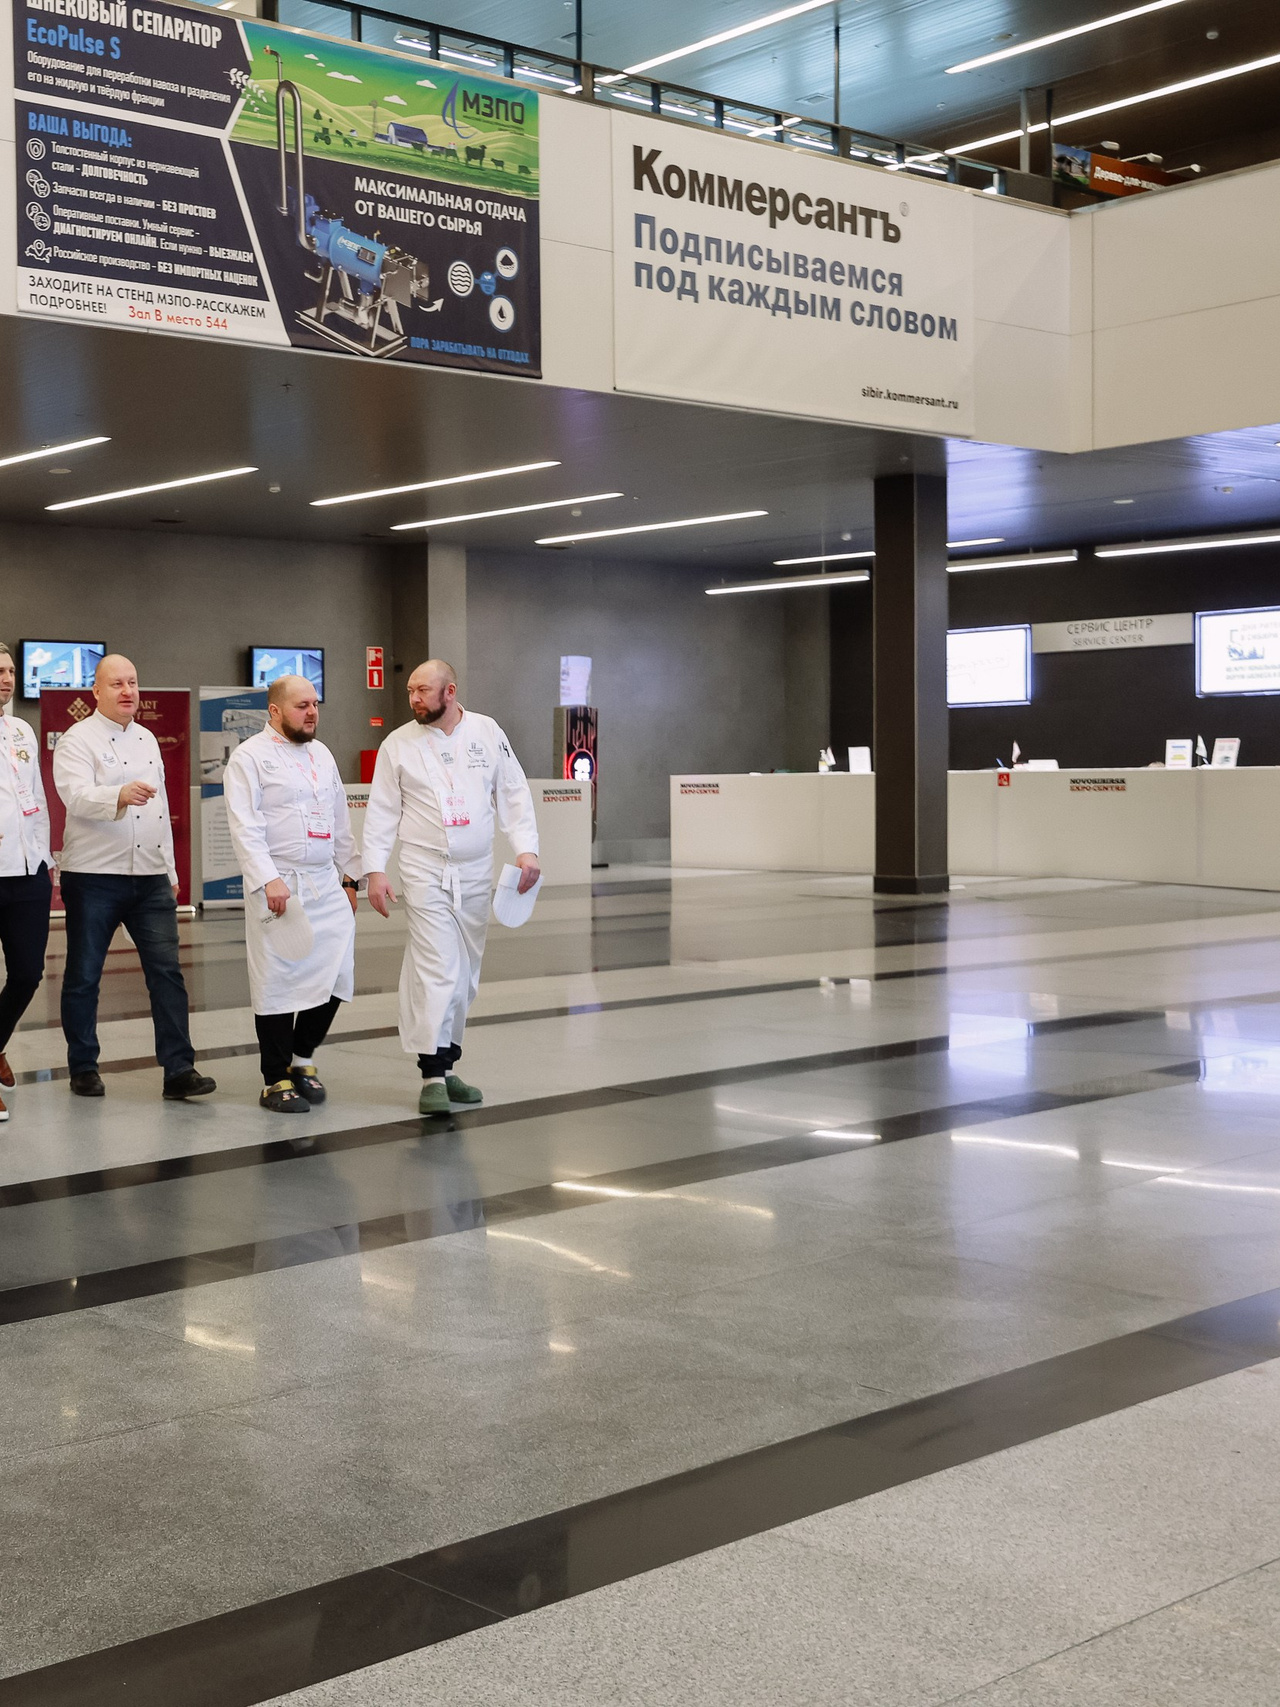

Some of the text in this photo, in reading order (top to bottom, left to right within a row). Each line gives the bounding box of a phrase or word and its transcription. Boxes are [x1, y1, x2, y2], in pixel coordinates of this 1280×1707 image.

[26, 18, 120, 60] EcoPulse S
[132, 8, 222, 49] СЕПАРАТОР
[27, 51, 231, 104] Оборудование для переработки навоза и разделения
[27, 71, 165, 108] его на жидкую и твёрдую фракции
[462, 89, 525, 125] МЗПО
[28, 112, 133, 148] ВАША ВЫГОДА:
[51, 141, 200, 179] Толстостенный корпус из нержавеющей
[51, 161, 74, 173] стали
[81, 164, 148, 186] ДОЛГОВЕЧНОСТЬ
[52, 181, 88, 198] Запчасти
[89, 189, 116, 203] всегда
[123, 195, 156, 209] наличии
[162, 199, 178, 213] БЕЗ
[178, 203, 217, 219] ПРОСТОЕВ
[354, 176, 527, 223] МАКСИМАЛЬНАЯ ОТДАЧА
[632, 144, 902, 244] Коммерсантъ
[52, 204, 104, 223] Оперативные
[141, 218, 169, 234] Умный
[169, 227, 195, 238] сервис
[354, 200, 483, 236] ОТ ВАШЕГО СЫРЬЯ
[52, 221, 123, 243] ДИАГНОСТИРУЕМ
[124, 231, 159, 248] ОНЛАЙН.
[160, 238, 178, 252] Если
[209, 246, 254, 263] ВЫЕЗЖАЕМ
[634, 212, 903, 297] Подписываемся
[53, 246, 98, 263] Российское
[157, 261, 173, 274] БЕЗ
[173, 264, 223, 281] ИМПОРТНЫХ
[28, 275, 266, 319] ЗАХОДИТЕ НА СТЕНД МЗПО-РАССКАЖЕМ
[29, 293, 108, 314] ПОДРОБНЕЕ!
[634, 261, 958, 342] под каждым словом
[128, 305, 151, 321] Зал
[166, 315, 202, 328] место
[206, 316, 228, 330] 544
[861, 385, 959, 409] sibir.kommersant.ru
[1066, 618, 1154, 635] СЕРВИС ЦЕНТР
[1072, 634, 1144, 646] SERVICE CENTER
